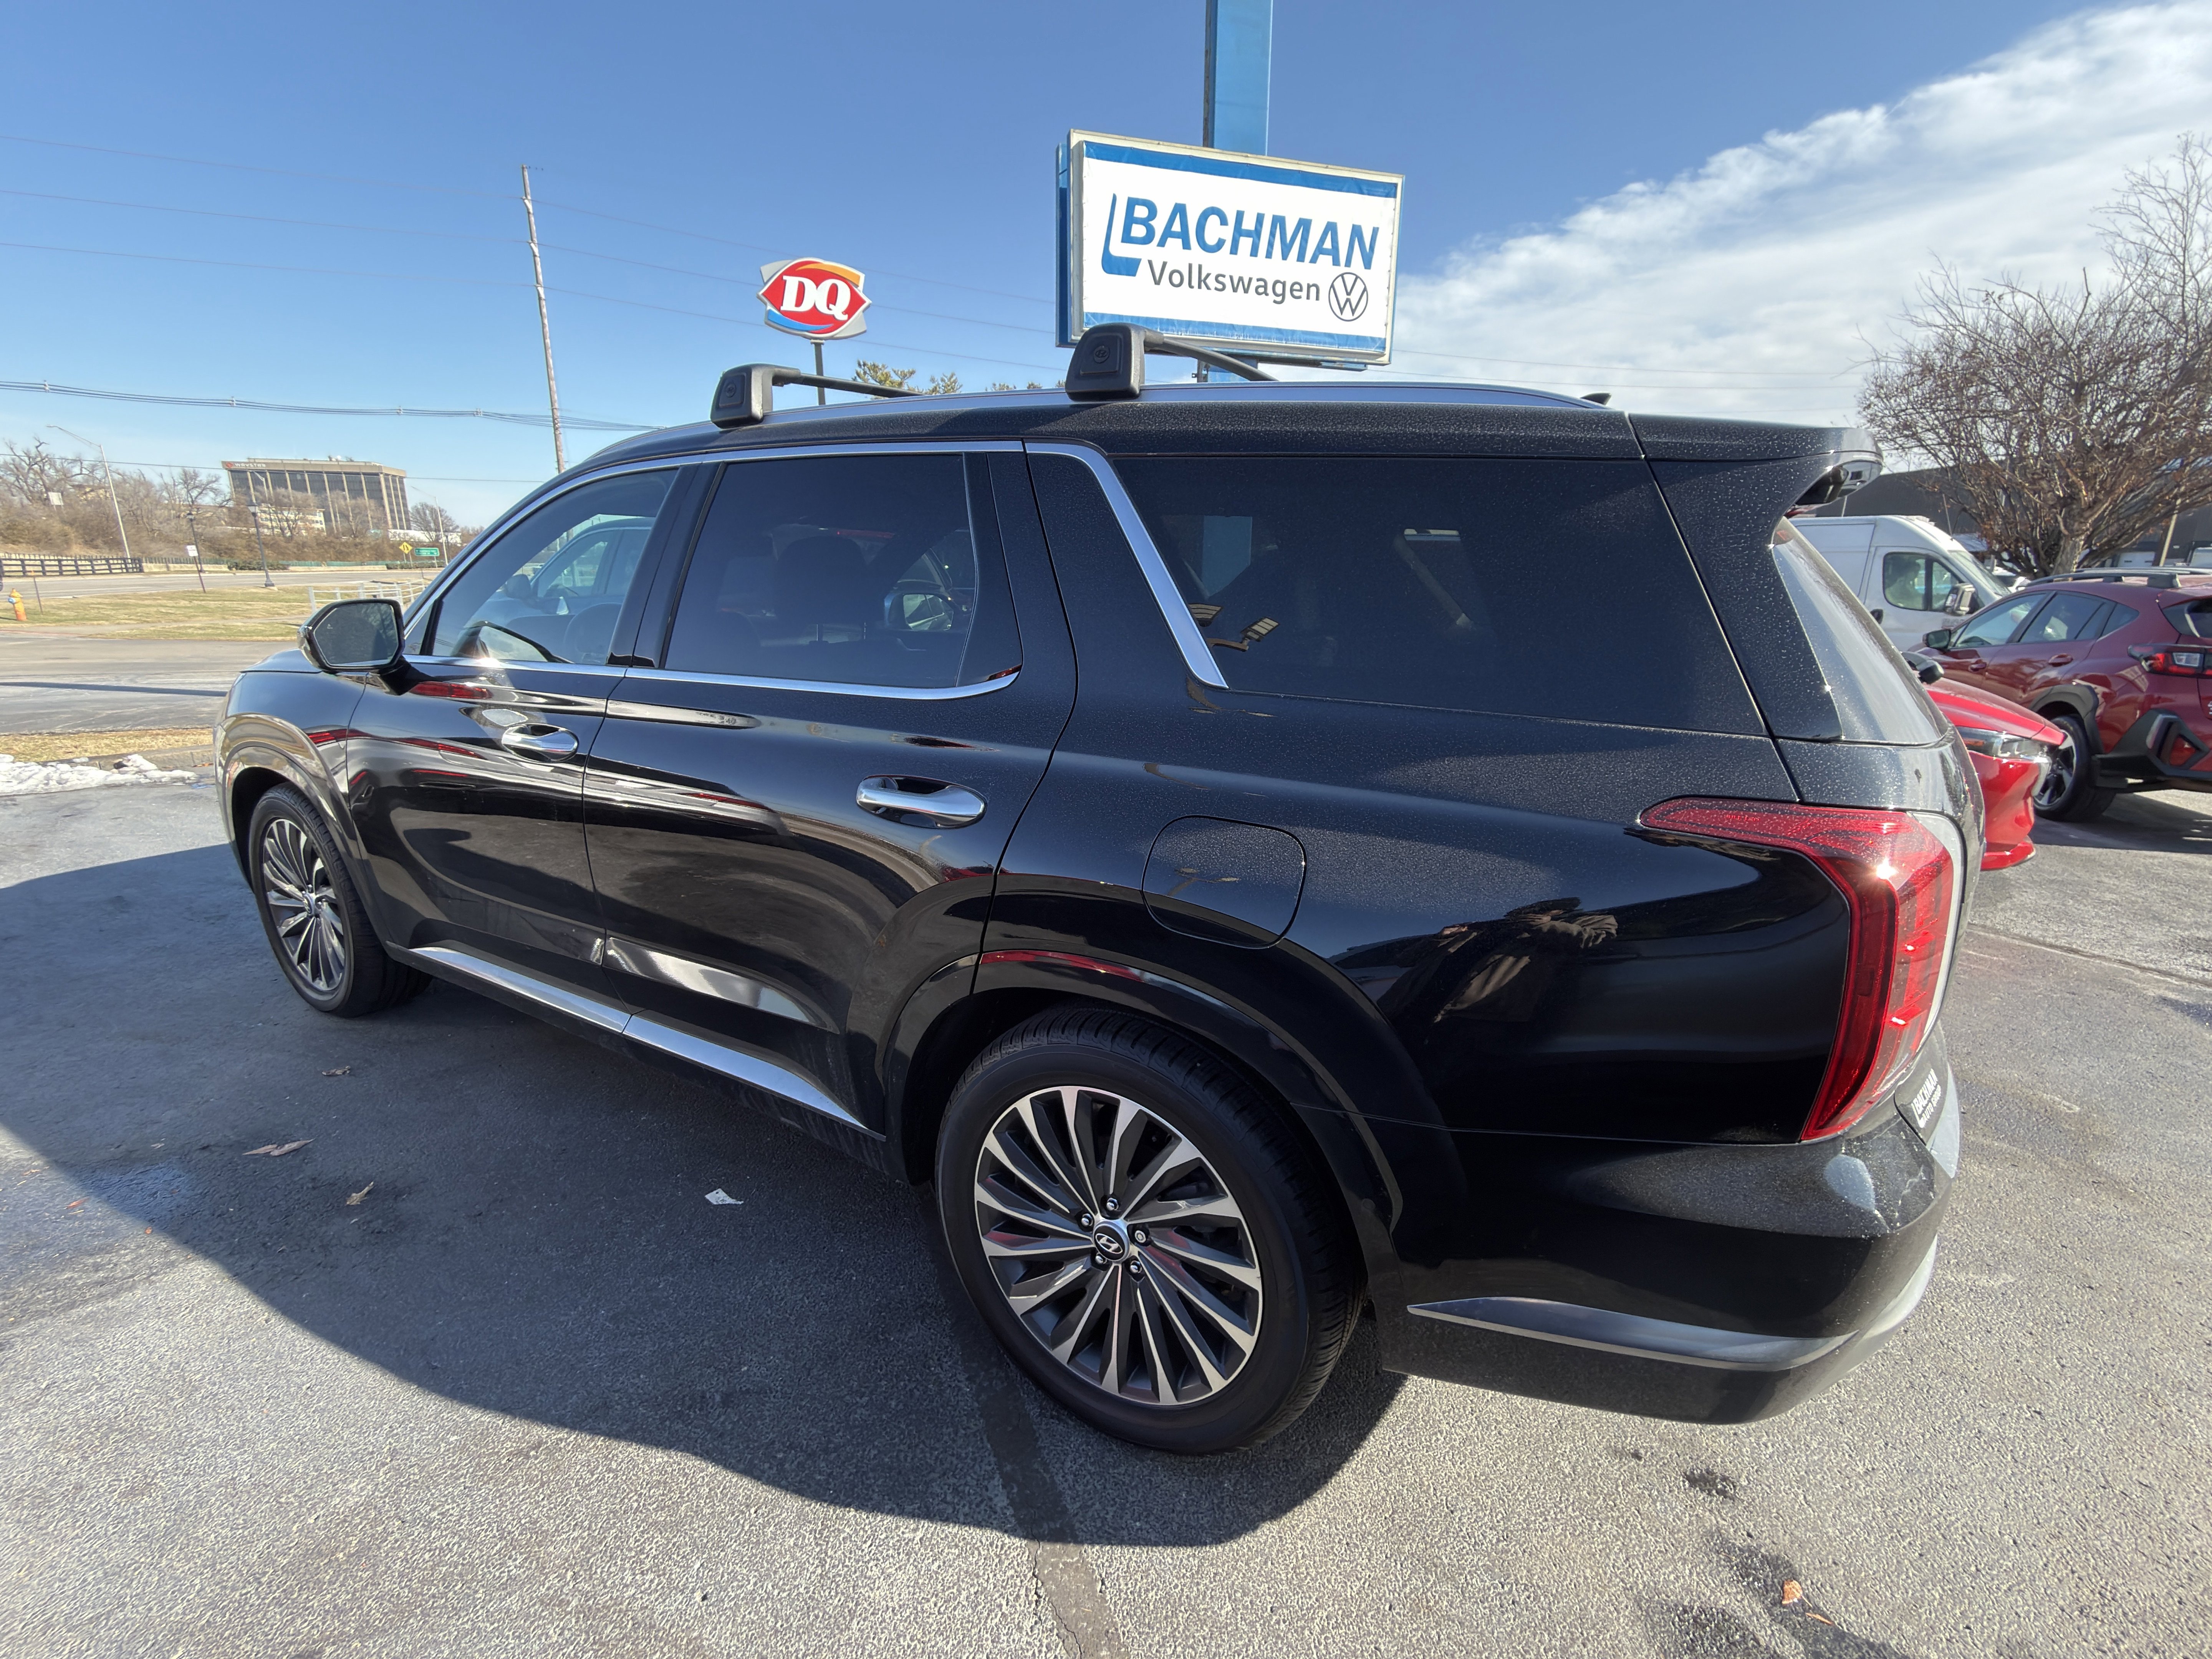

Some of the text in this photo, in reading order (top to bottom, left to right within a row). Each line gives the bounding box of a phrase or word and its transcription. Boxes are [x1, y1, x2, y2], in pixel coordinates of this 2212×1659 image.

[1120, 196, 1379, 270] BACHMAN
[780, 275, 851, 321] DQ
[1147, 260, 1320, 305] Volkswagen
[1913, 1068, 1939, 1114] BACHMAN
[1922, 1084, 1942, 1123] AUTO GROUP
